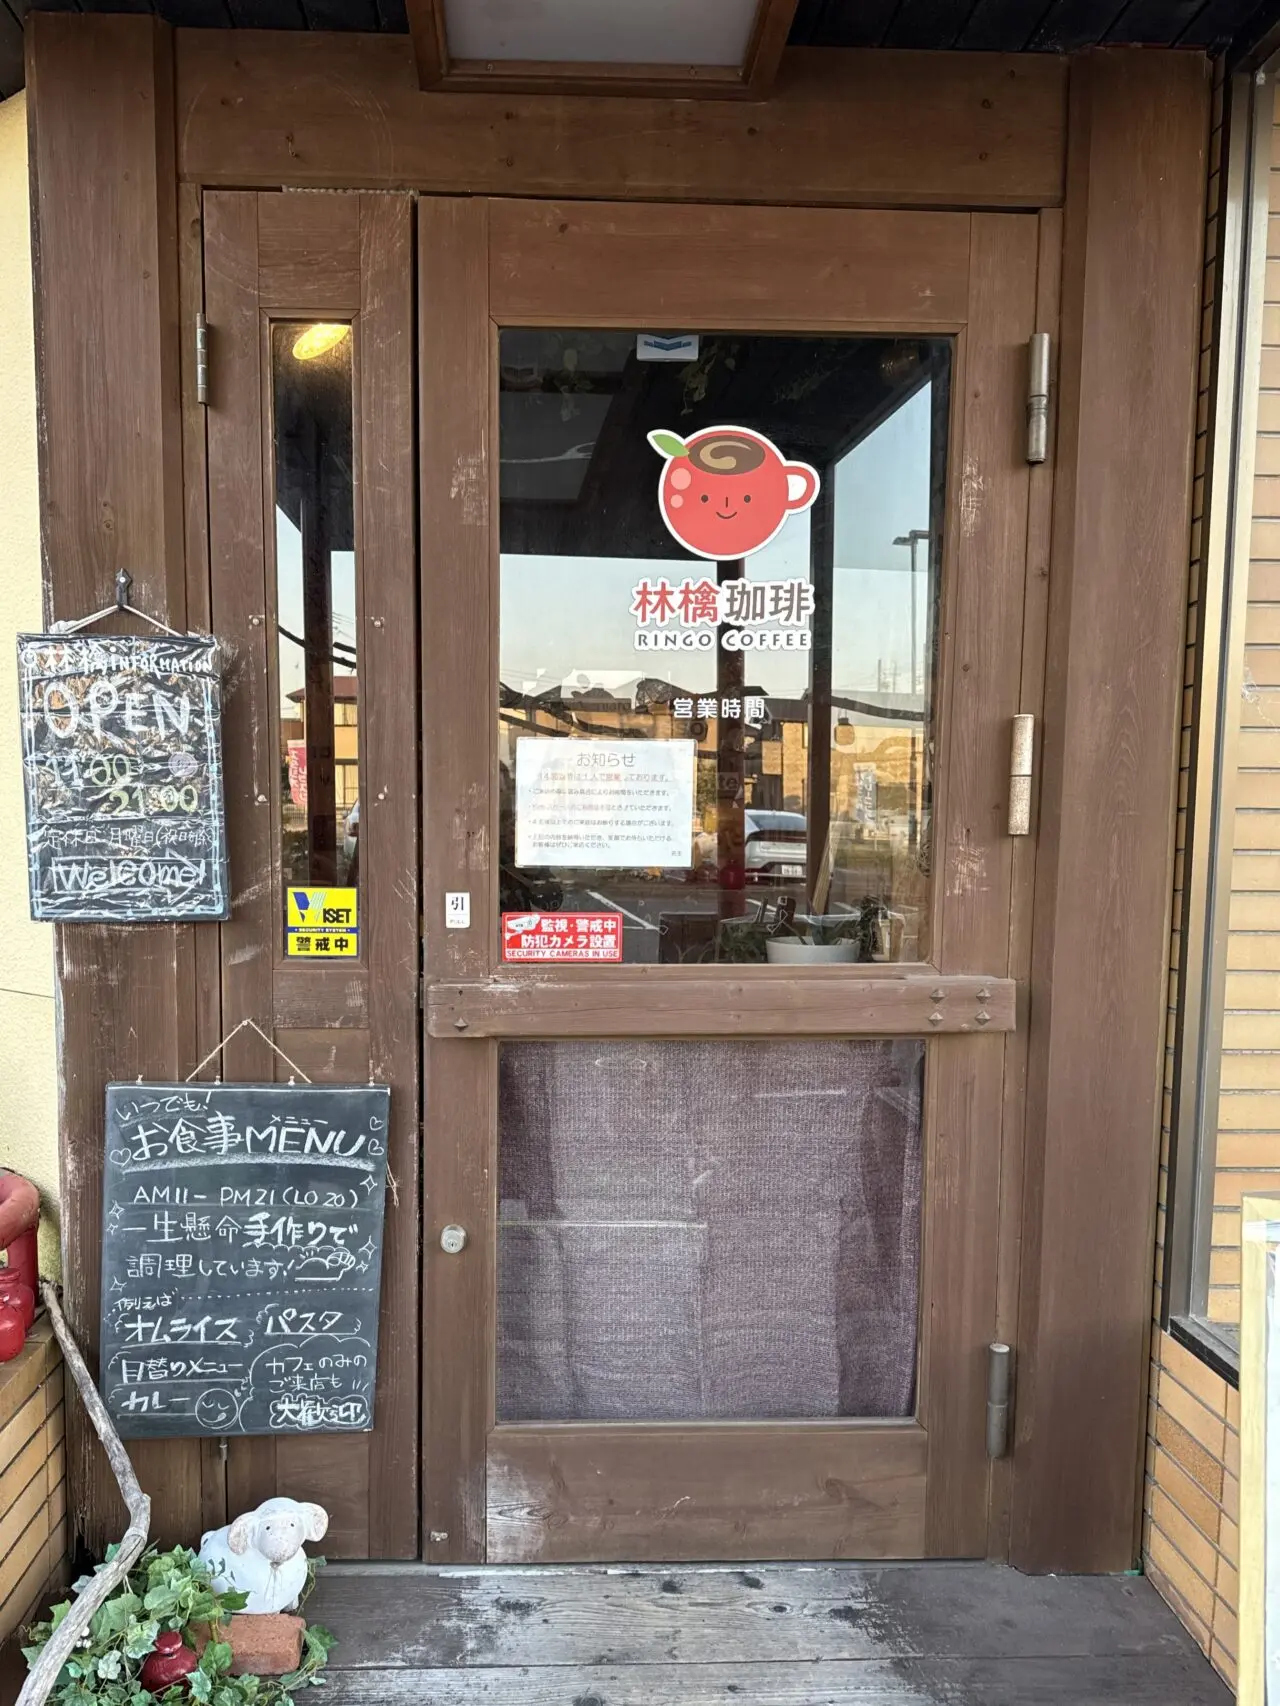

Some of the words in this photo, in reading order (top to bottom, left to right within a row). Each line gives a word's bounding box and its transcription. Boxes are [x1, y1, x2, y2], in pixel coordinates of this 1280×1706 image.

[633, 580, 811, 624] 林檎珈琲
[638, 633, 712, 647] RINGO
[726, 633, 809, 647] COFFEE
[44, 680, 190, 741] OPEN
[673, 698, 765, 719] 営業時間
[576, 752, 636, 768] お知らせ
[451, 896, 464, 911] 引
[540, 918, 617, 933] 監視・警戒中
[296, 936, 349, 952] 警戒中
[521, 934, 617, 949] 防犯カメラ設置
[507, 950, 546, 958] SECURITY
[549, 950, 590, 958] CAMERAS
[592, 950, 600, 958] IN
[602, 950, 618, 958] USE
[115, 1090, 212, 1121] いつでも!
[270, 1113, 329, 1125] メニュー
[114, 1288, 179, 1311] 例えば
[125, 1314, 239, 1343] オムライス
[266, 1308, 344, 1334] パスタ
[265, 1353, 368, 1376] カフェのみの
[269, 1374, 344, 1394] ご来店も
[121, 1390, 191, 1412] カレー
[276, 1397, 367, 1427] 大歓迎
